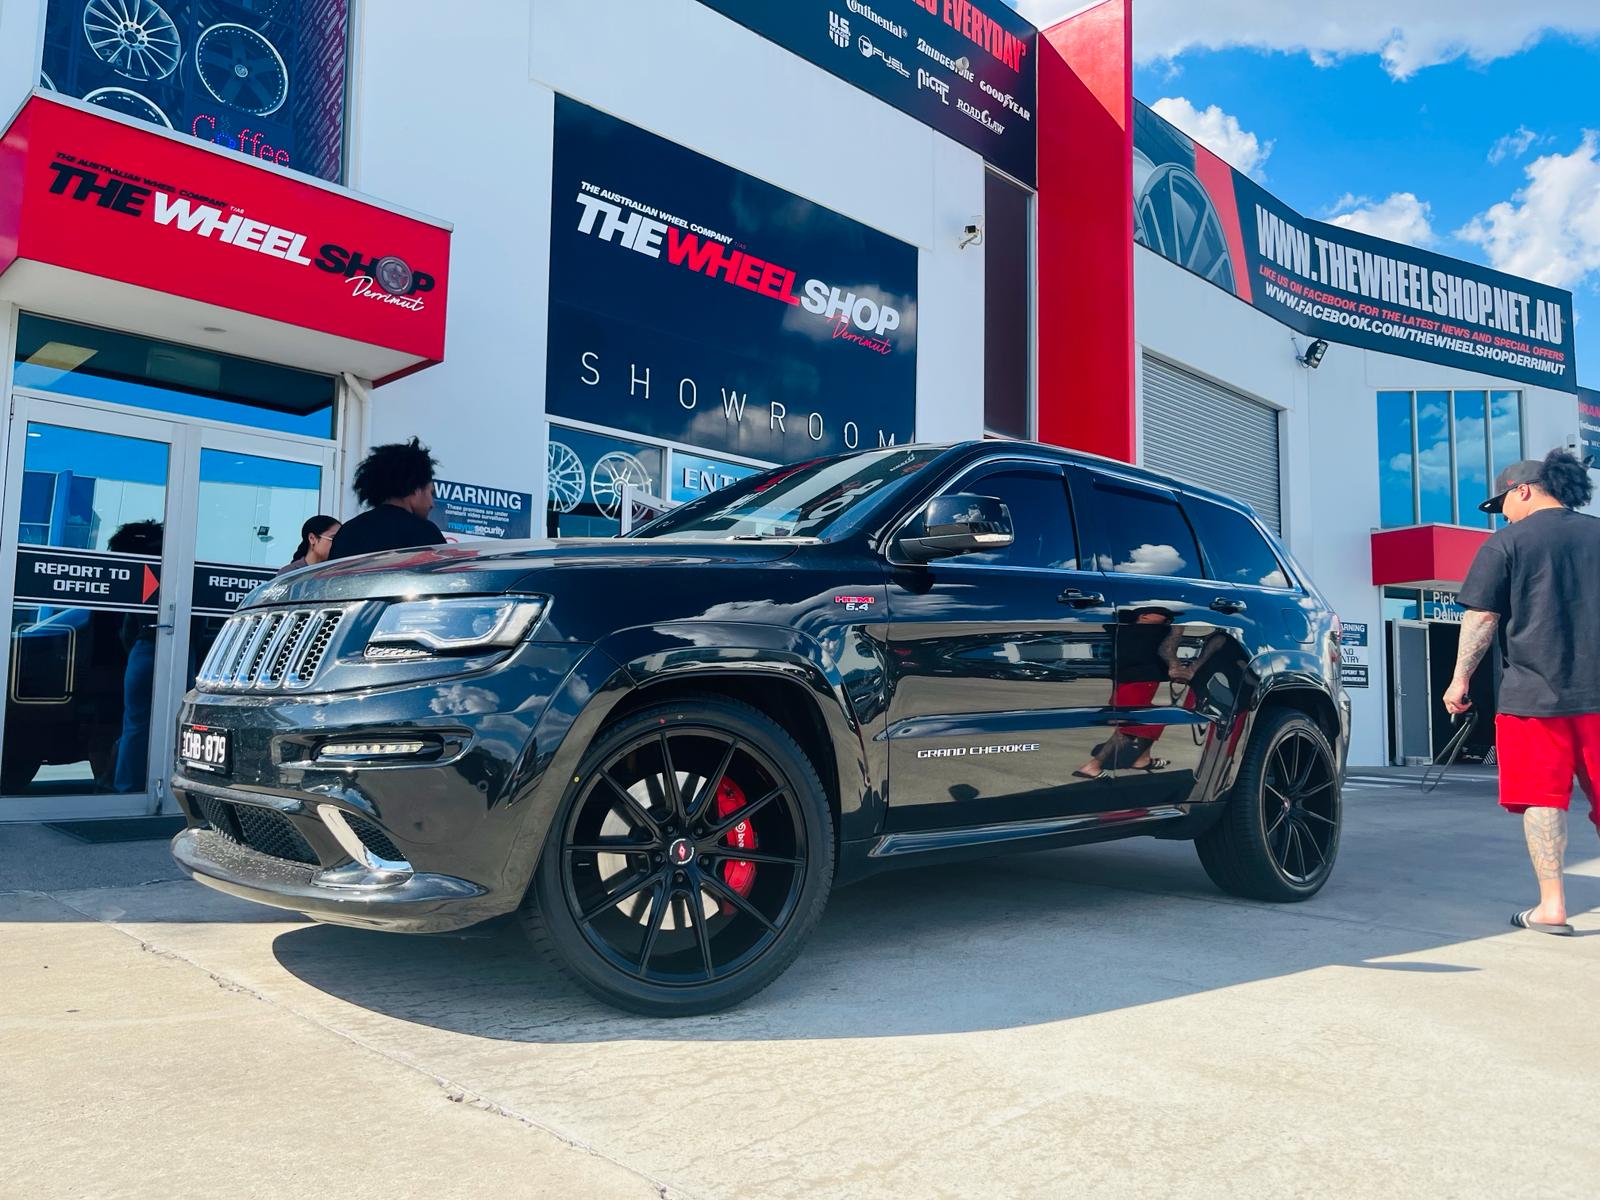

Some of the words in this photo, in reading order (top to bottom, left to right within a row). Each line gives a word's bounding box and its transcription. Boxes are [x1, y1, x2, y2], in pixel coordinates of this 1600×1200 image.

[192, 114, 290, 168] Coffee
[56, 152, 76, 162] THE
[77, 156, 141, 182] AUSTRALIAN
[143, 178, 176, 193] WHEEL
[179, 189, 228, 207] COMPANY
[49, 161, 152, 217] THE
[154, 191, 311, 266] WHEEL
[314, 242, 435, 295] SHOP
[581, 181, 600, 195] THE
[600, 189, 658, 217] AUSTRALIAN
[659, 211, 689, 229] WHEEL
[690, 223, 733, 245] COMPANY
[576, 192, 668, 259] THE
[667, 225, 800, 307] WHEEL
[800, 279, 900, 336] SHOP
[345, 275, 424, 311] Derrimut
[1259, 264, 1276, 281] LIKE
[1277, 274, 1289, 288] US
[1290, 281, 1303, 294] ON
[1303, 287, 1356, 311] FACEBOOK
[1358, 304, 1379, 317] FOR
[1382, 309, 1401, 322] THE
[1402, 314, 1440, 331] LATEST
[1441, 324, 1470, 338] NEWS
[1471, 332, 1492, 344] AND
[1494, 336, 1531, 353] SPECIAL
[1532, 346, 1565, 361] OFFERS
[1266, 281, 1565, 376] WWW.FACEBOOK.COM/THEWHEELSHOPDERRIMUT
[826, 314, 892, 355] Derrimut
[580, 351, 896, 448] SHOWROOM
[434, 481, 521, 510] WARNING
[683, 466, 740, 493] ENT
[34, 562, 103, 578] REPORT
[109, 568, 131, 581] TO
[53, 579, 110, 595] OFFICE
[835, 596, 875, 604] HEMI
[845, 603, 869, 611] 6.4
[1433, 591, 1456, 605] Pick
[1433, 607, 1464, 621] Delive
[1341, 655, 1360, 664] NTRY
[917, 747, 967, 759] GRAND
[969, 743, 1040, 756] CHEROKEE
